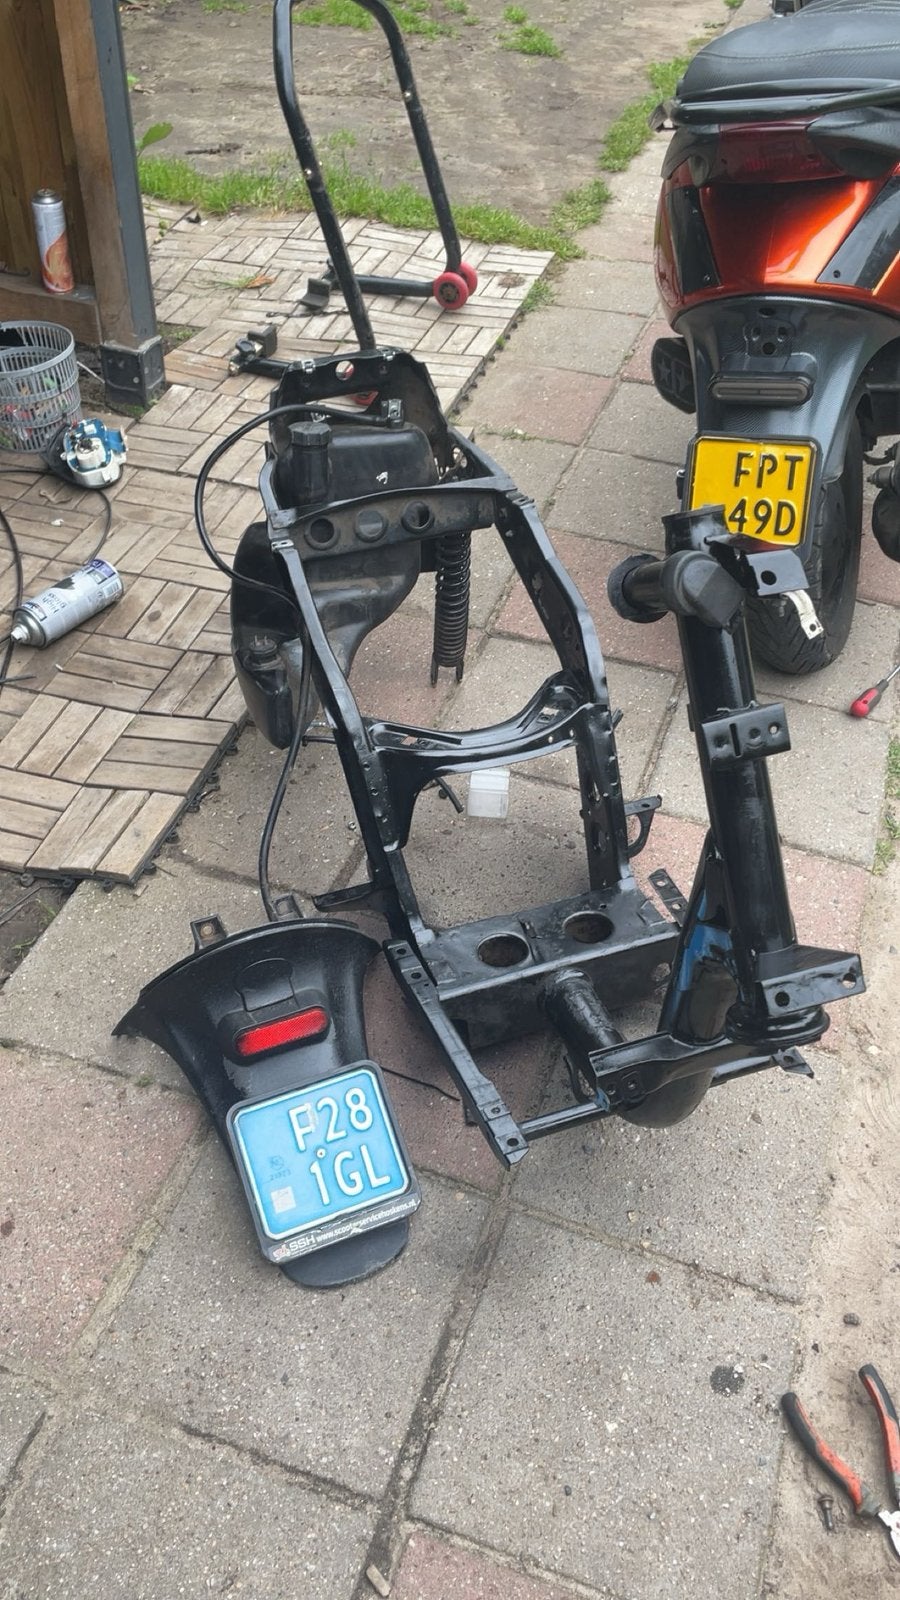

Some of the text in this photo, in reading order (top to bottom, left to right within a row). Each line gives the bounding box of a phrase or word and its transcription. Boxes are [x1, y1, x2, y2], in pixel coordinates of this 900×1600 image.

[733, 452, 804, 491] FPT
[728, 498, 796, 536] 49D
[288, 1087, 374, 1152] F28
[309, 1144, 391, 1206] 1GL
[288, 1235, 317, 1252] SSH
